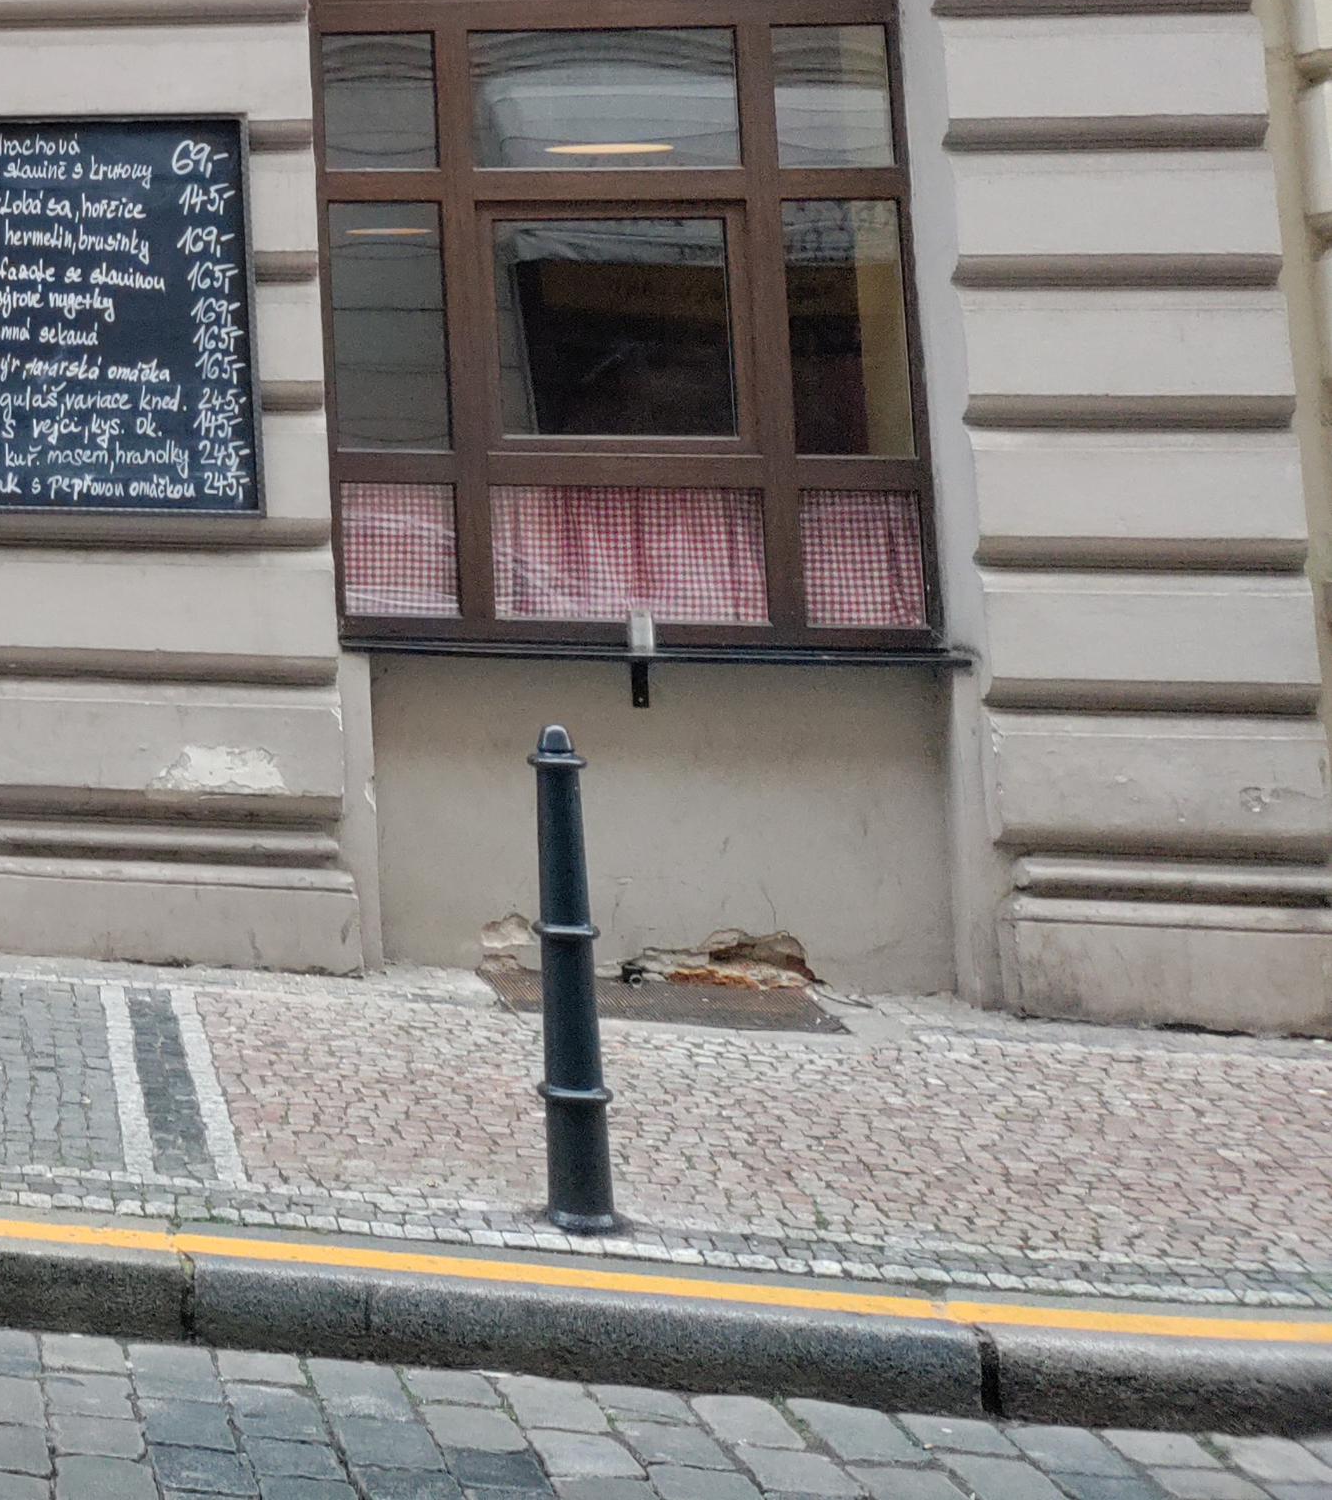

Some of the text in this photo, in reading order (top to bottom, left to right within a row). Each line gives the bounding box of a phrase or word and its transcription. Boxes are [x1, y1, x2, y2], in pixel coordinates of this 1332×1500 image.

[3, 158, 67, 179] slanině
[72, 162, 83, 179] s
[172, 140, 229, 178] 69,-
[81, 192, 146, 219] hořčice
[179, 183, 235, 216] 145,-
[78, 225, 149, 265] brusinky
[177, 226, 235, 258] 169,-
[64, 267, 82, 283] se
[89, 262, 166, 292] slaninou
[187, 261, 239, 294] 165,-
[48, 287, 115, 322] nugetky
[190, 297, 240, 328] 169,-
[39, 322, 98, 345] sekaná
[193, 324, 244, 353] 165,-
[107, 358, 170, 383] omáčka
[195, 351, 246, 385] 165,-
[66, 391, 132, 411] variace
[198, 388, 247, 415] 245,-
[1, 419, 15, 439] s
[193, 410, 242, 439] 145,-
[116, 440, 189, 479] hranolky
[198, 440, 251, 472] 245,-
[31, 477, 41, 494] s
[47, 473, 124, 501] pepřovou
[129, 474, 196, 499] omáčkou
[204, 471, 250, 502] 245,-
